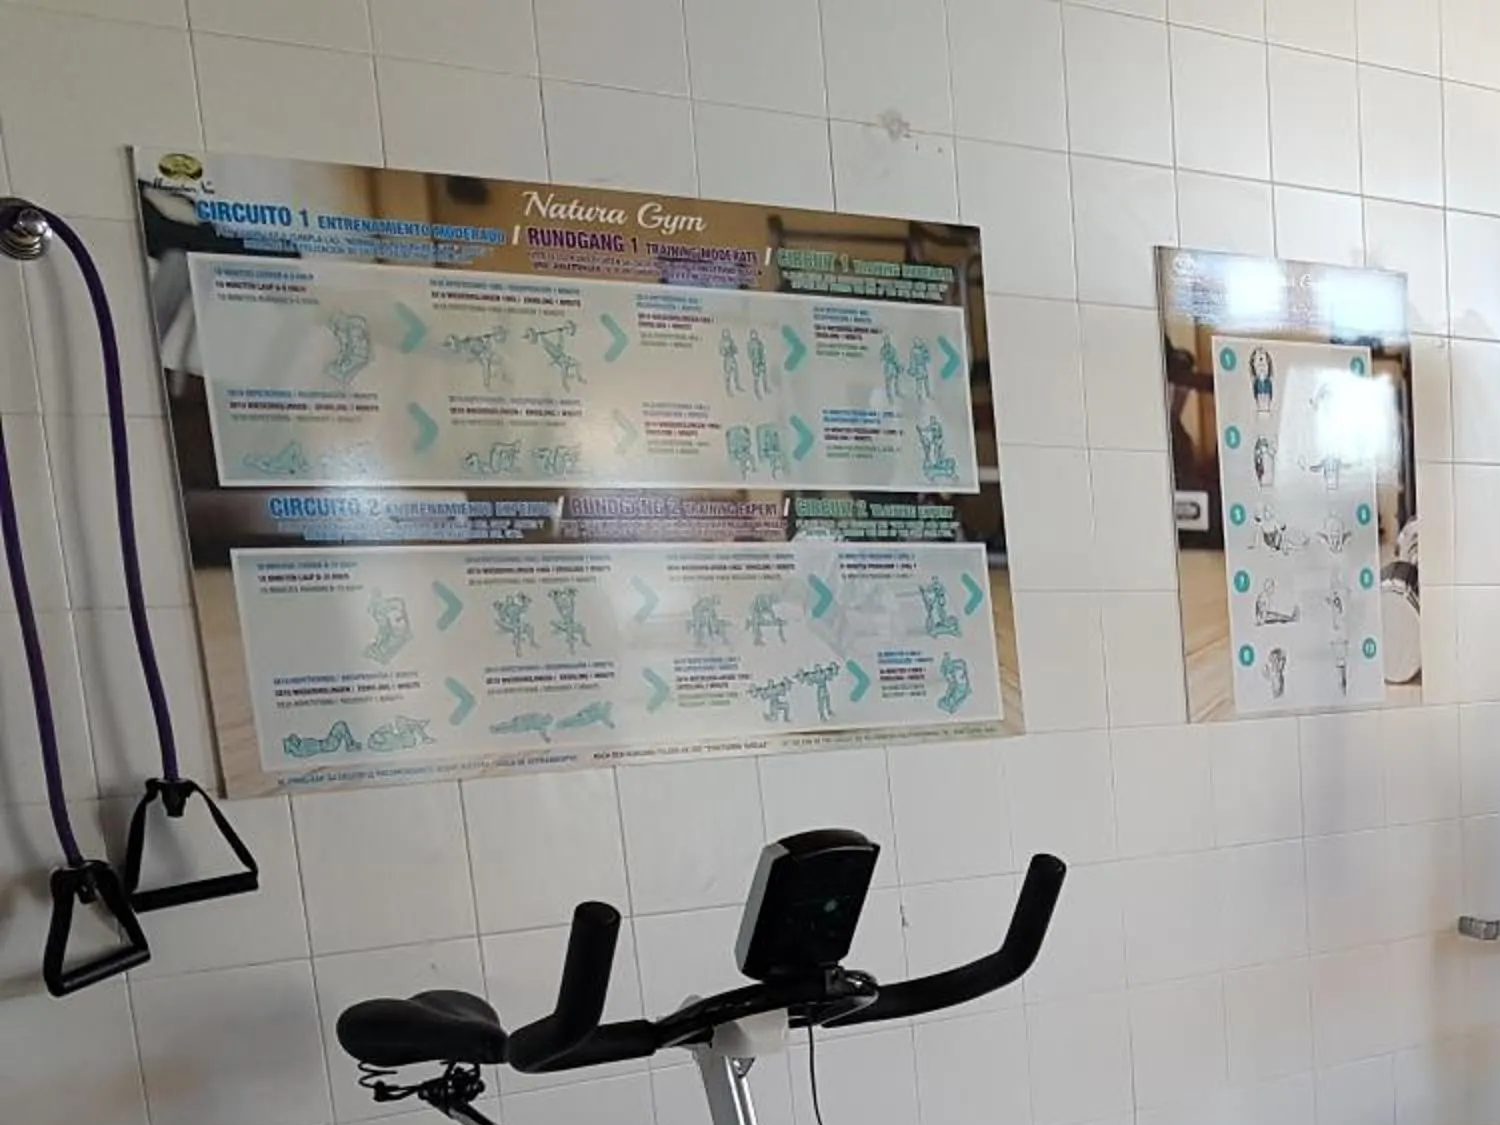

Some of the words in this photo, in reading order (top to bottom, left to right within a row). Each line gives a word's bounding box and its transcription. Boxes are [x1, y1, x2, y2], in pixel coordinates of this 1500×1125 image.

[197, 200, 292, 228] CIRCUITO
[299, 208, 310, 228] 1
[522, 190, 628, 225] Natura
[637, 202, 706, 235] Gym
[527, 227, 624, 253] RUNDGANG
[631, 237, 638, 253] 1
